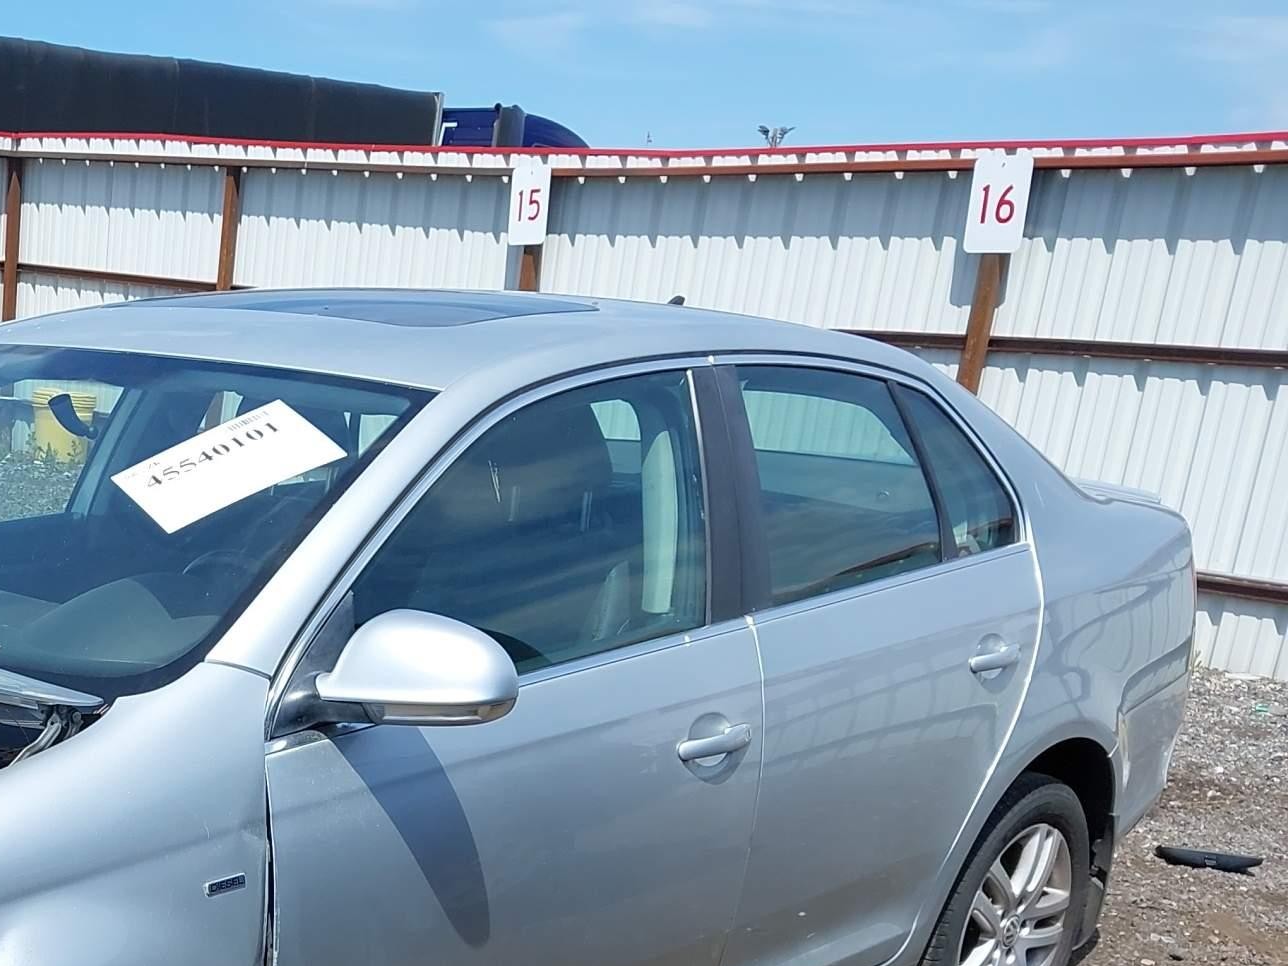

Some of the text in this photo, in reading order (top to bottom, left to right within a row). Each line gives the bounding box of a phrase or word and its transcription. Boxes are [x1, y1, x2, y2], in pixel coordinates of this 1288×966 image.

[518, 188, 542, 222] 15
[979, 184, 1015, 224] 16
[147, 421, 281, 488] 45540101
[209, 875, 245, 893] DIESEL
